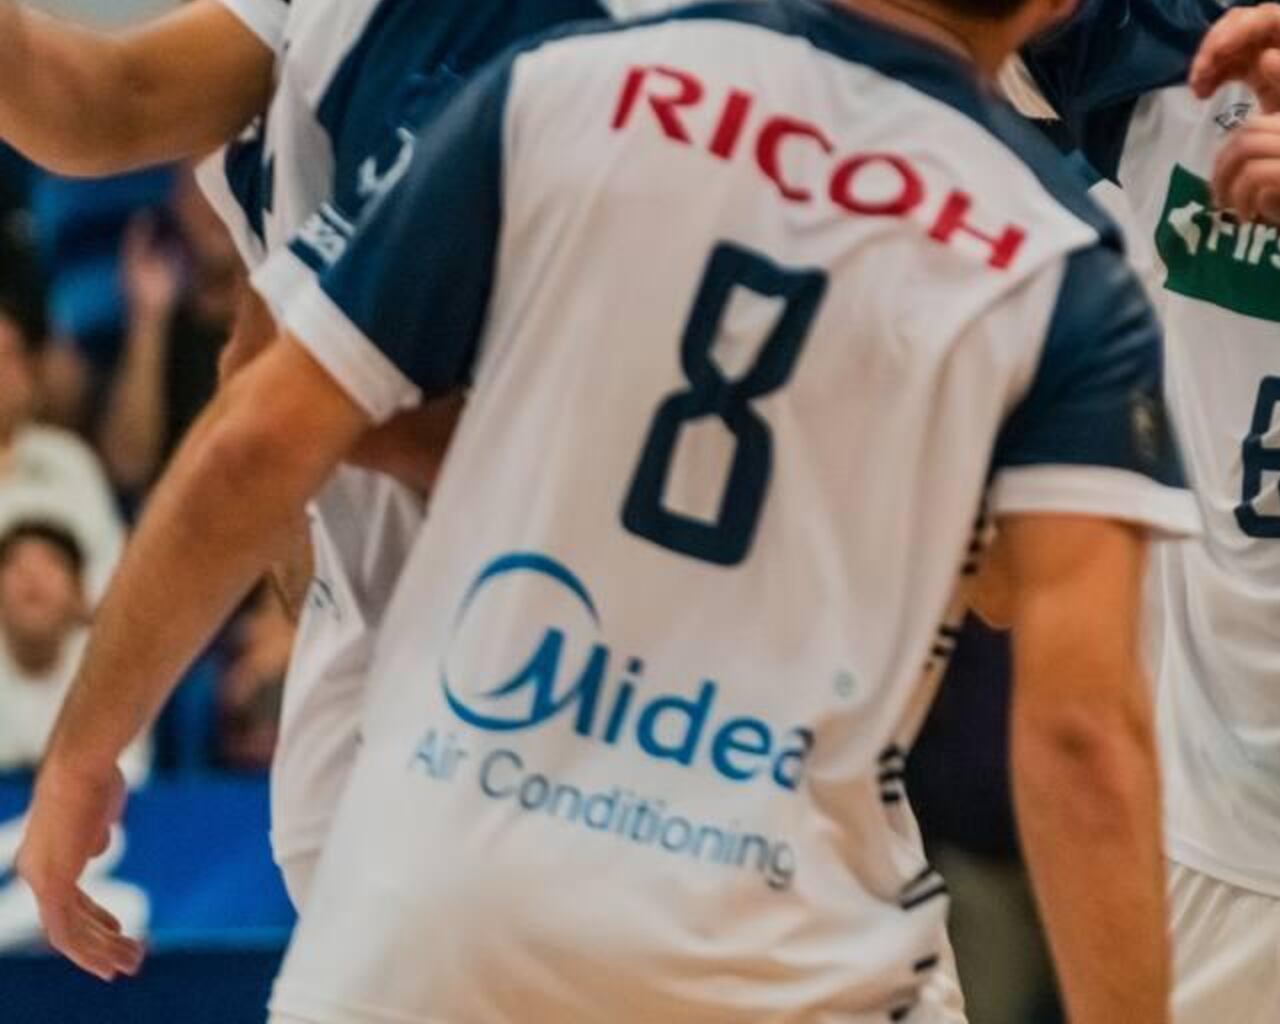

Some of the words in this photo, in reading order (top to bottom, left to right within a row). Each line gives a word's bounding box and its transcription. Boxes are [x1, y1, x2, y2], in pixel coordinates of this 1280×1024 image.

[611, 64, 1026, 274] RICOH
[620, 239, 829, 567] 8
[474, 626, 814, 790] Midea
[411, 727, 468, 783] Air
[477, 747, 796, 892] Conditioning
